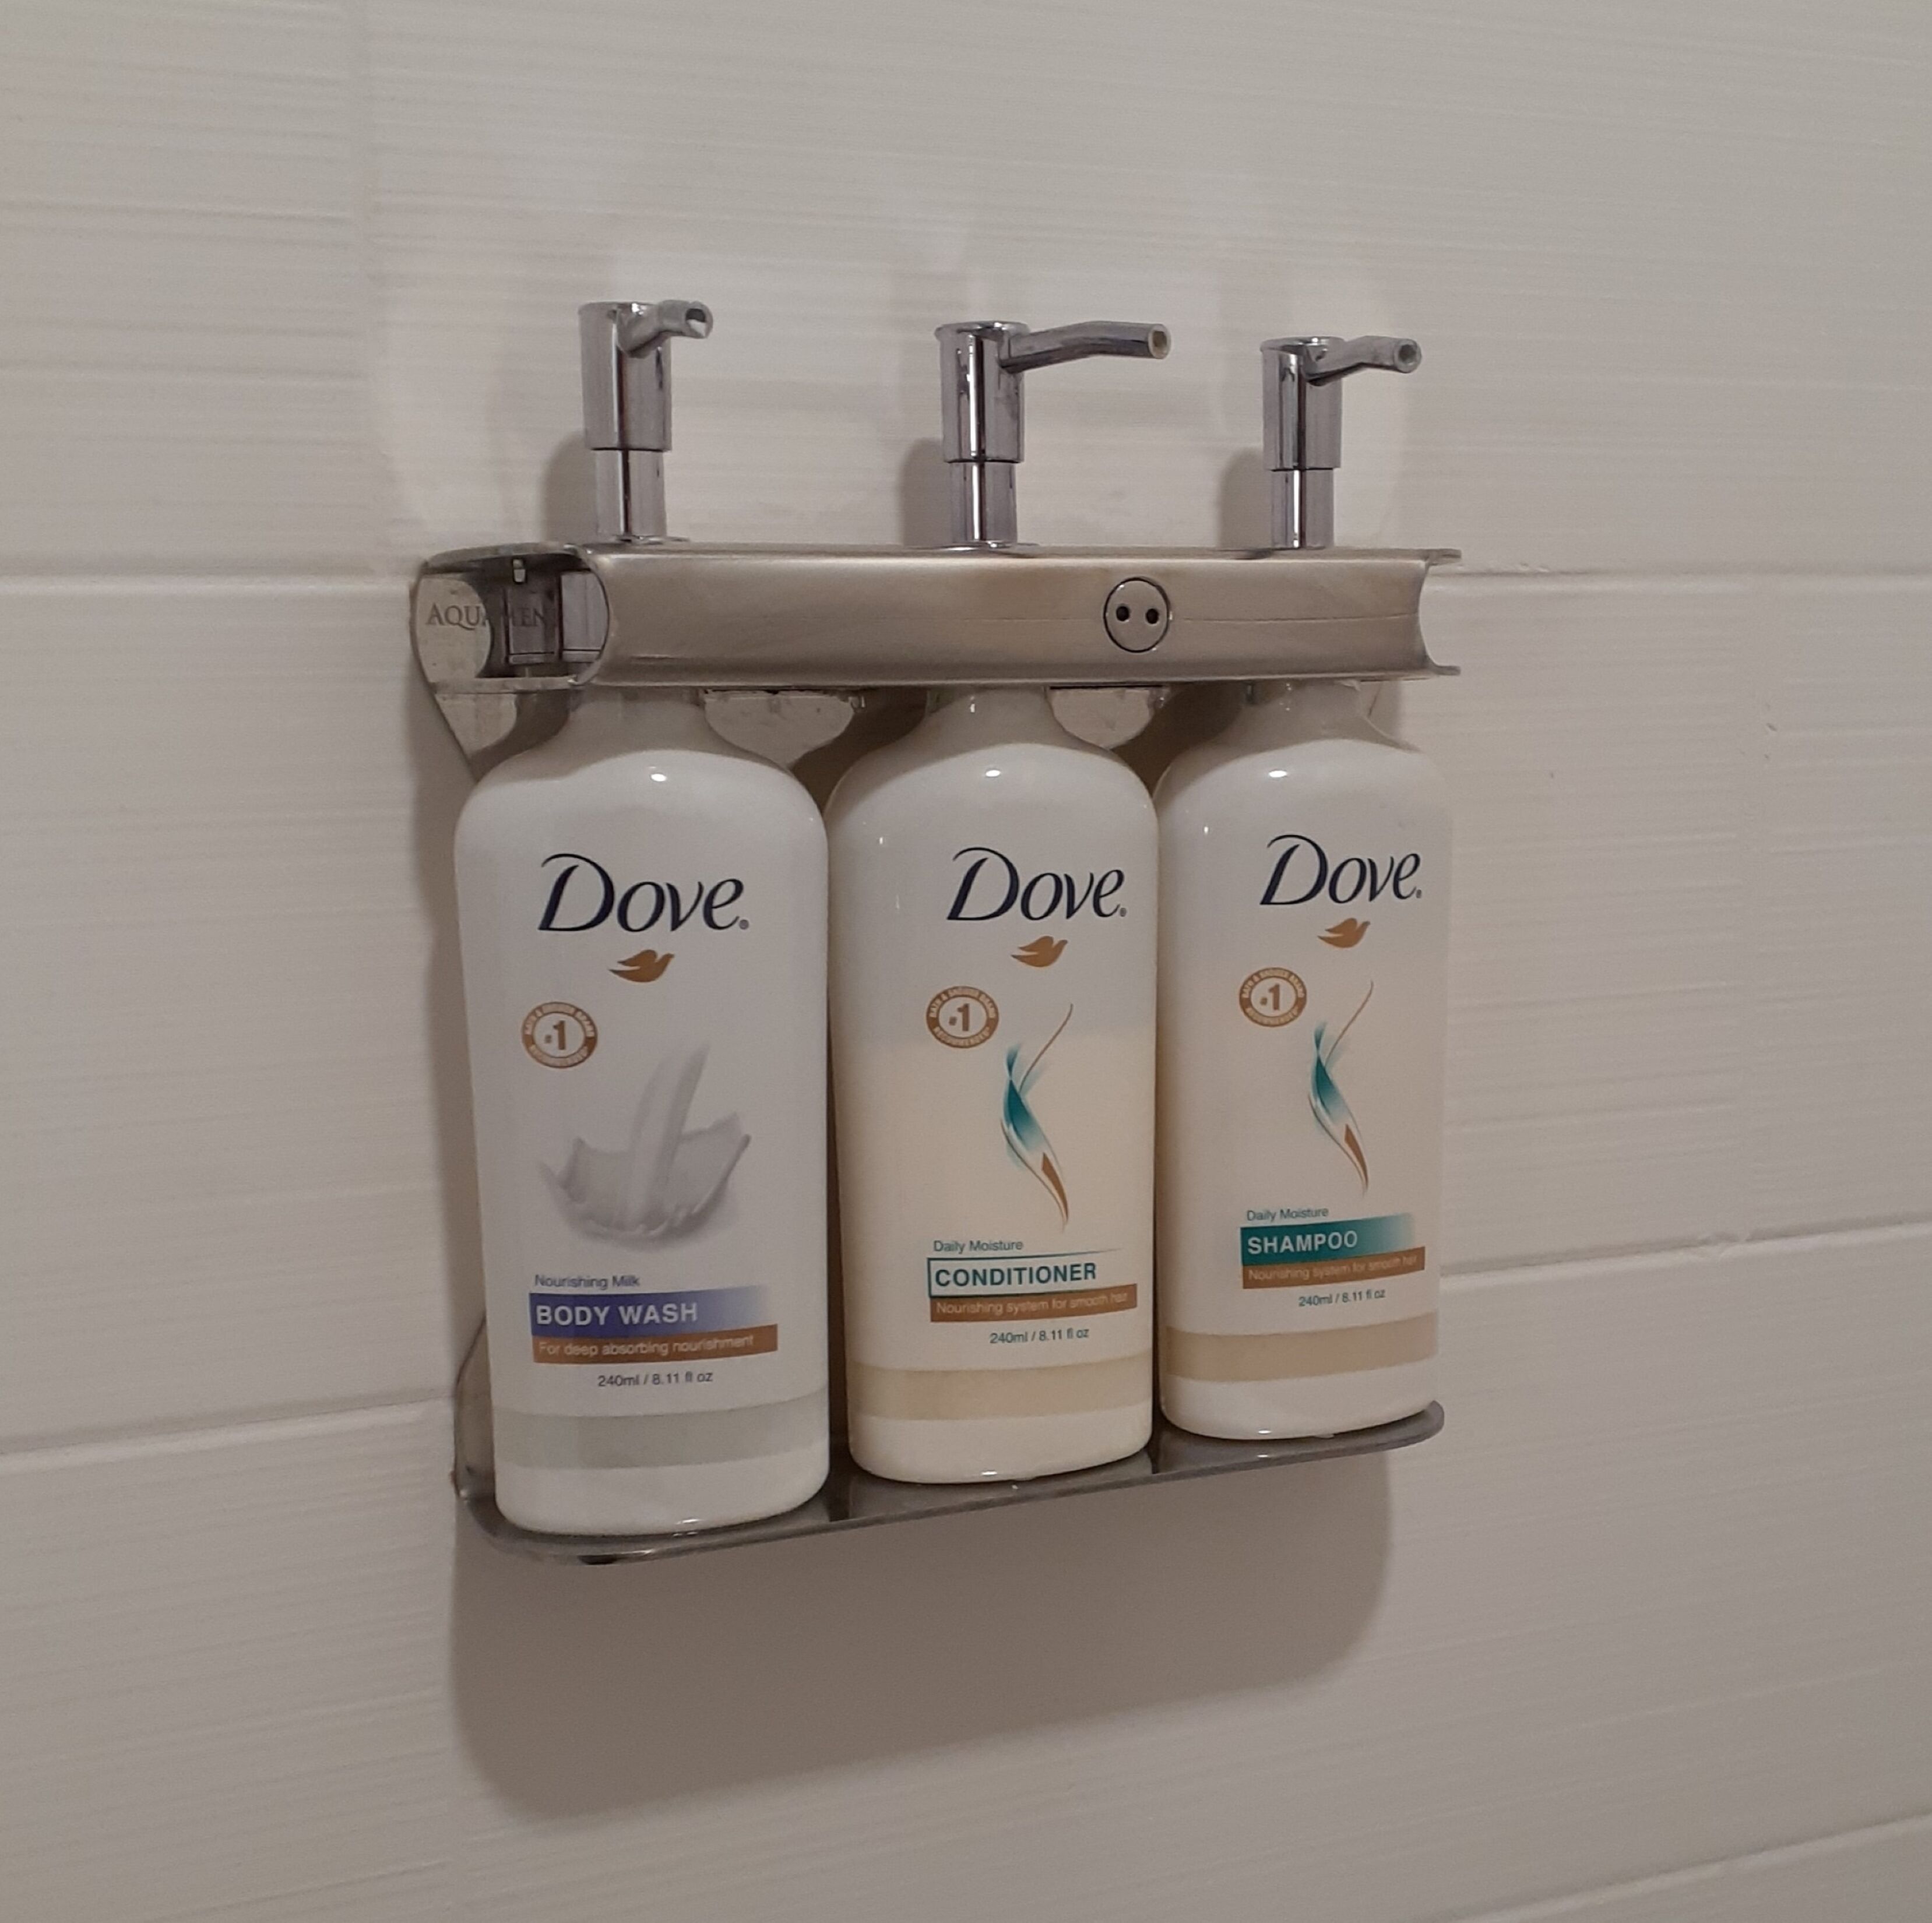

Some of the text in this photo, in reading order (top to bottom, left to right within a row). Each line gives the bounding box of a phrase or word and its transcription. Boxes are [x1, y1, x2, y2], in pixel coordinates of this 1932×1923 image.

[1259, 834, 1420, 905] Dove
[537, 853, 744, 932] Dove
[946, 847, 1125, 921] Dove
[1259, 983, 1280, 1010] 1
[948, 1002, 970, 1032] 1
[544, 1020, 566, 1051] 1
[1247, 1207, 1329, 1223] Daily Moisture
[934, 1239, 1023, 1255] Daily Moisture
[1247, 1230, 1358, 1255] SHAMPOO
[534, 1273, 640, 1290] Nourishing Milk
[935, 1262, 1096, 1287] CONDITIONER
[1248, 1267, 1310, 1282] Nourishing
[1352, 1260, 1366, 1272] for
[936, 1301, 1004, 1316] Nourishing
[1052, 1297, 1068, 1309] for
[1298, 1294, 1333, 1307] 240ml
[1374, 1290, 1386, 1299] oz
[536, 1302, 698, 1326] BODY WASH
[539, 1333, 754, 1358] For deep absorbing nourishment
[990, 1331, 1028, 1344] 240ml
[1039, 1329, 1062, 1341] 8.11
[1076, 1329, 1089, 1339] oz
[597, 1373, 640, 1387] 240ml
[652, 1372, 680, 1385] 8.11
[696, 1372, 713, 1383] oz
